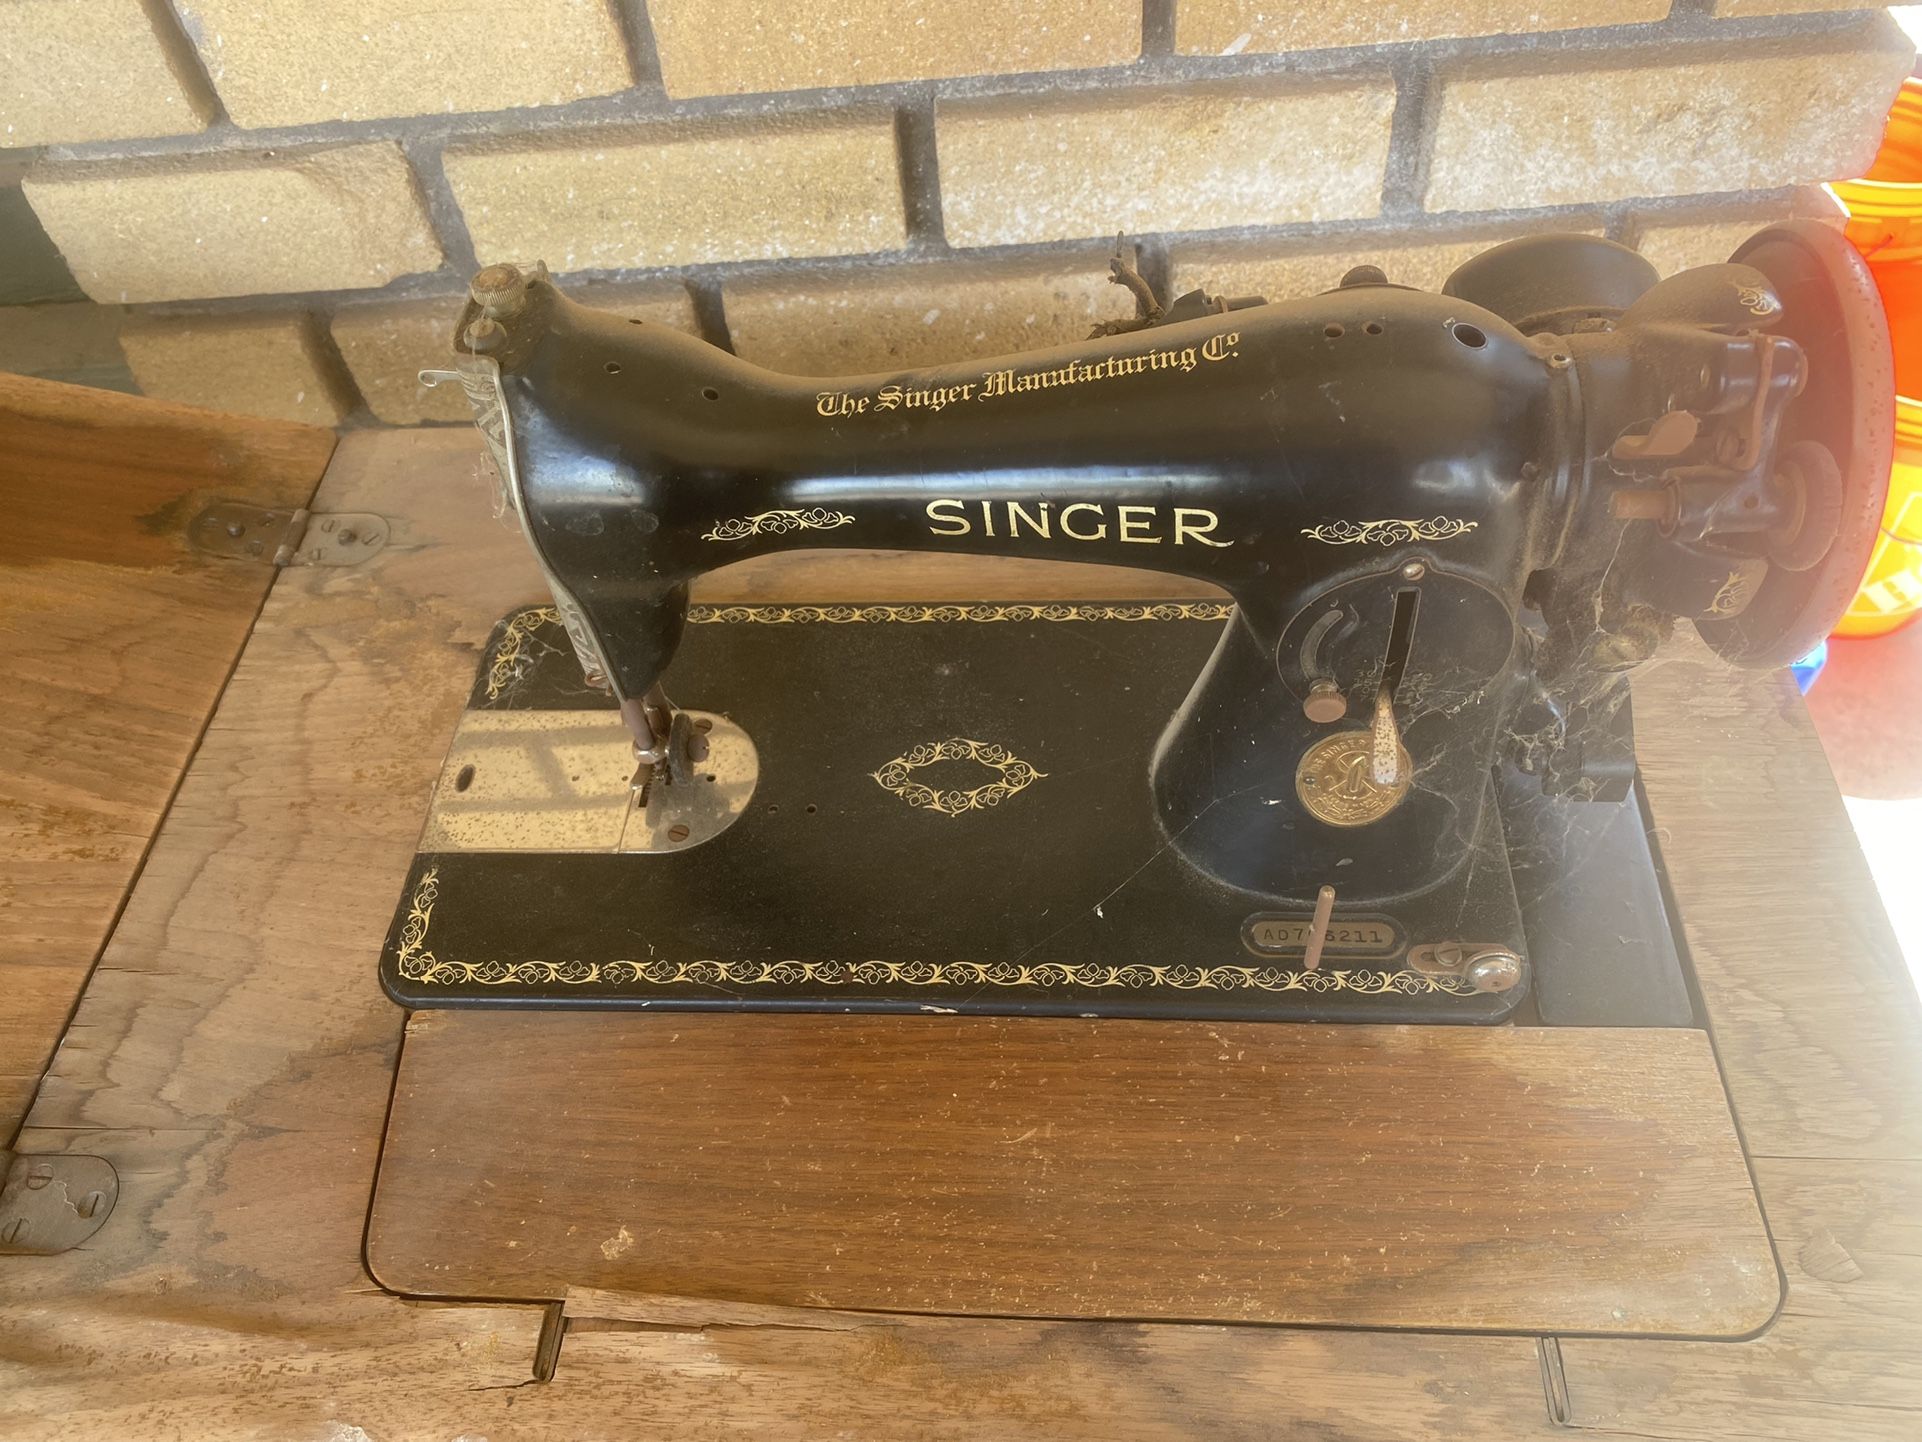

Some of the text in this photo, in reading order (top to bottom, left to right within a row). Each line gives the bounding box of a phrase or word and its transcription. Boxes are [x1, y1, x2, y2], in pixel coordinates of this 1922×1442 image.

[816, 391, 869, 418] The
[874, 384, 977, 412] Singer
[978, 347, 1197, 402] Manufacturing
[925, 499, 1236, 548] SINGER
[1263, 927, 1383, 943] AD76211
